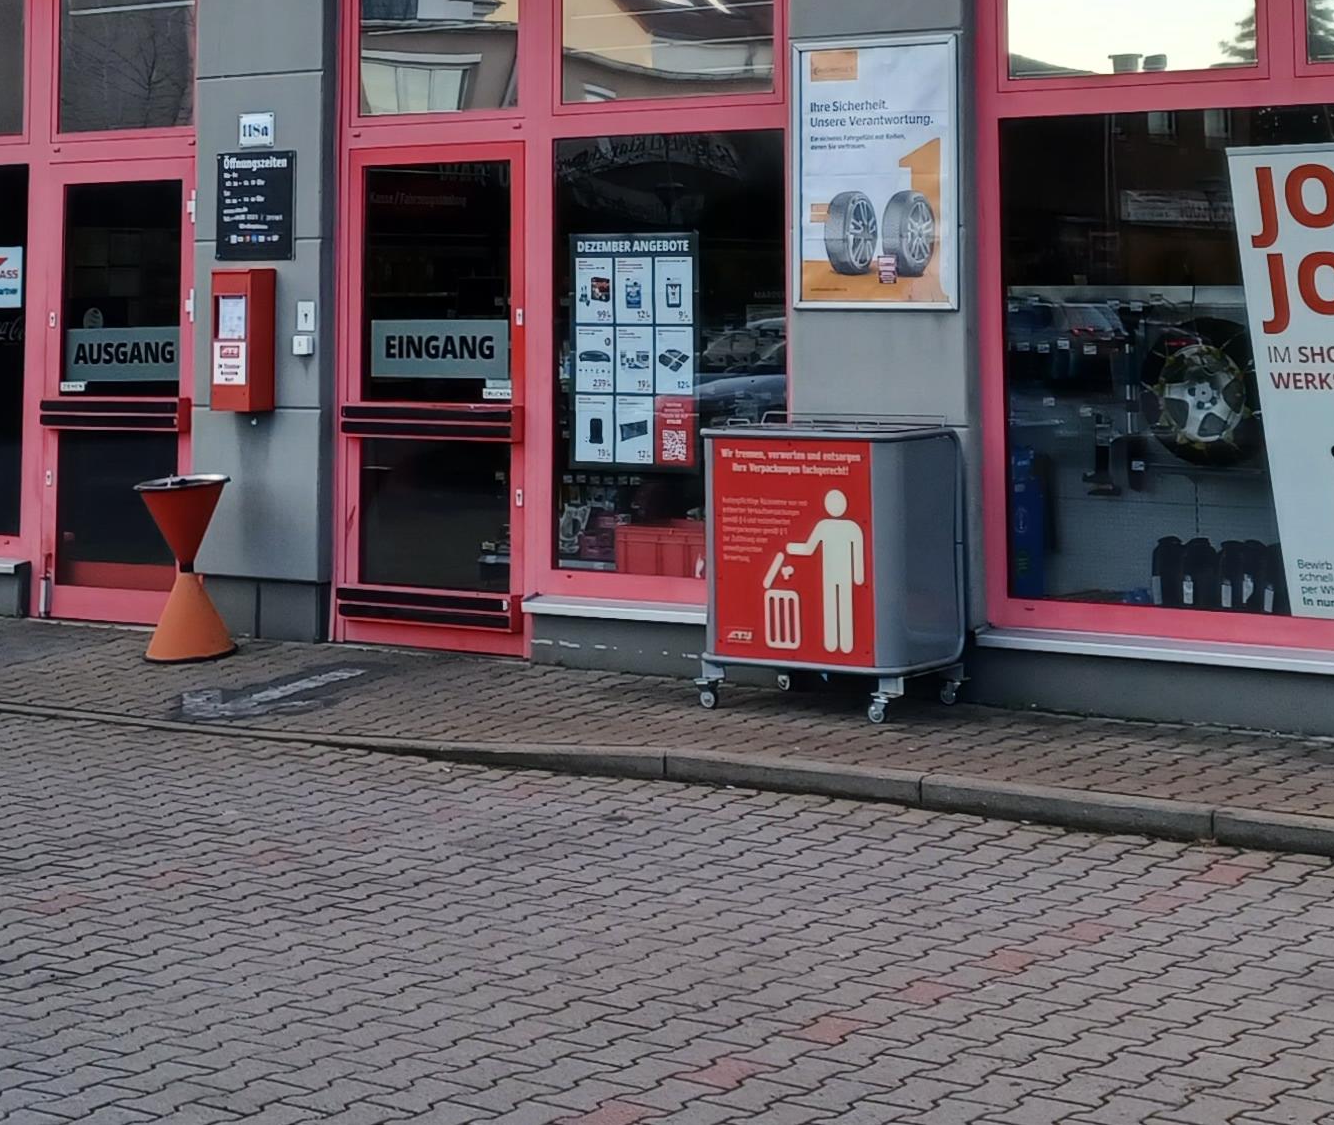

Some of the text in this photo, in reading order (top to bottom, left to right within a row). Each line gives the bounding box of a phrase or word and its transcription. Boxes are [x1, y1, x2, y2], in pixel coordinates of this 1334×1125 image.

[810, 102, 830, 112] Ihre
[810, 114, 934, 128] Unsere Verantwortung.
[223, 156, 287, 171] Öffnungszeiten
[577, 240, 690, 253] DEZEMBER ANGEBOTE
[73, 341, 175, 365] AUSGANG
[385, 335, 495, 359] EINGANG
[1268, 346, 1291, 364] IM
[807, 451, 821, 460] und
[748, 463, 800, 475] Verpackungen
[1297, 559, 1332, 570] Bewirb
[1299, 572, 1334, 582] schnell
[1301, 586, 1317, 595] per
[1302, 597, 1314, 606] In
[1316, 599, 1334, 607] nur
